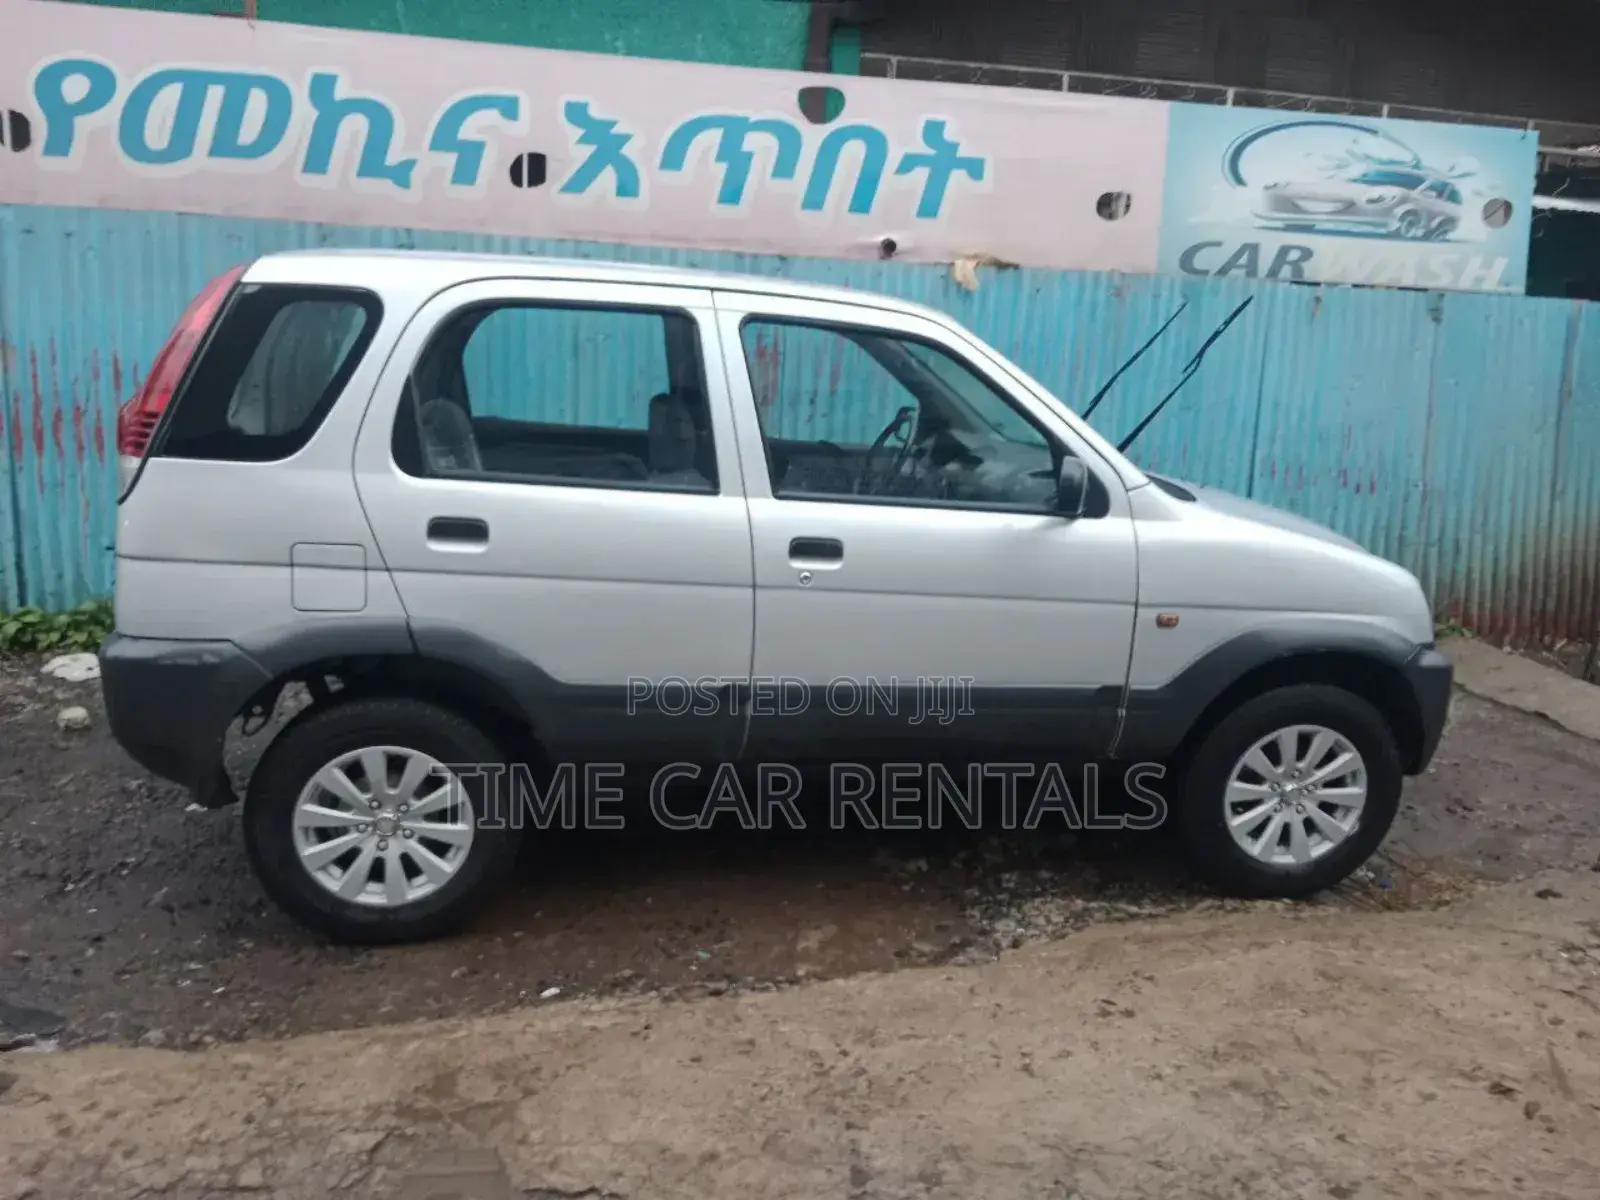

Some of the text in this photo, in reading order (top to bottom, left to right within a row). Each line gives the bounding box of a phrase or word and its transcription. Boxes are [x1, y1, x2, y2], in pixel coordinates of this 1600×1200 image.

[33, 58, 985, 219] የመኪና እጥበት
[1178, 240, 1508, 288] CAR WASH
